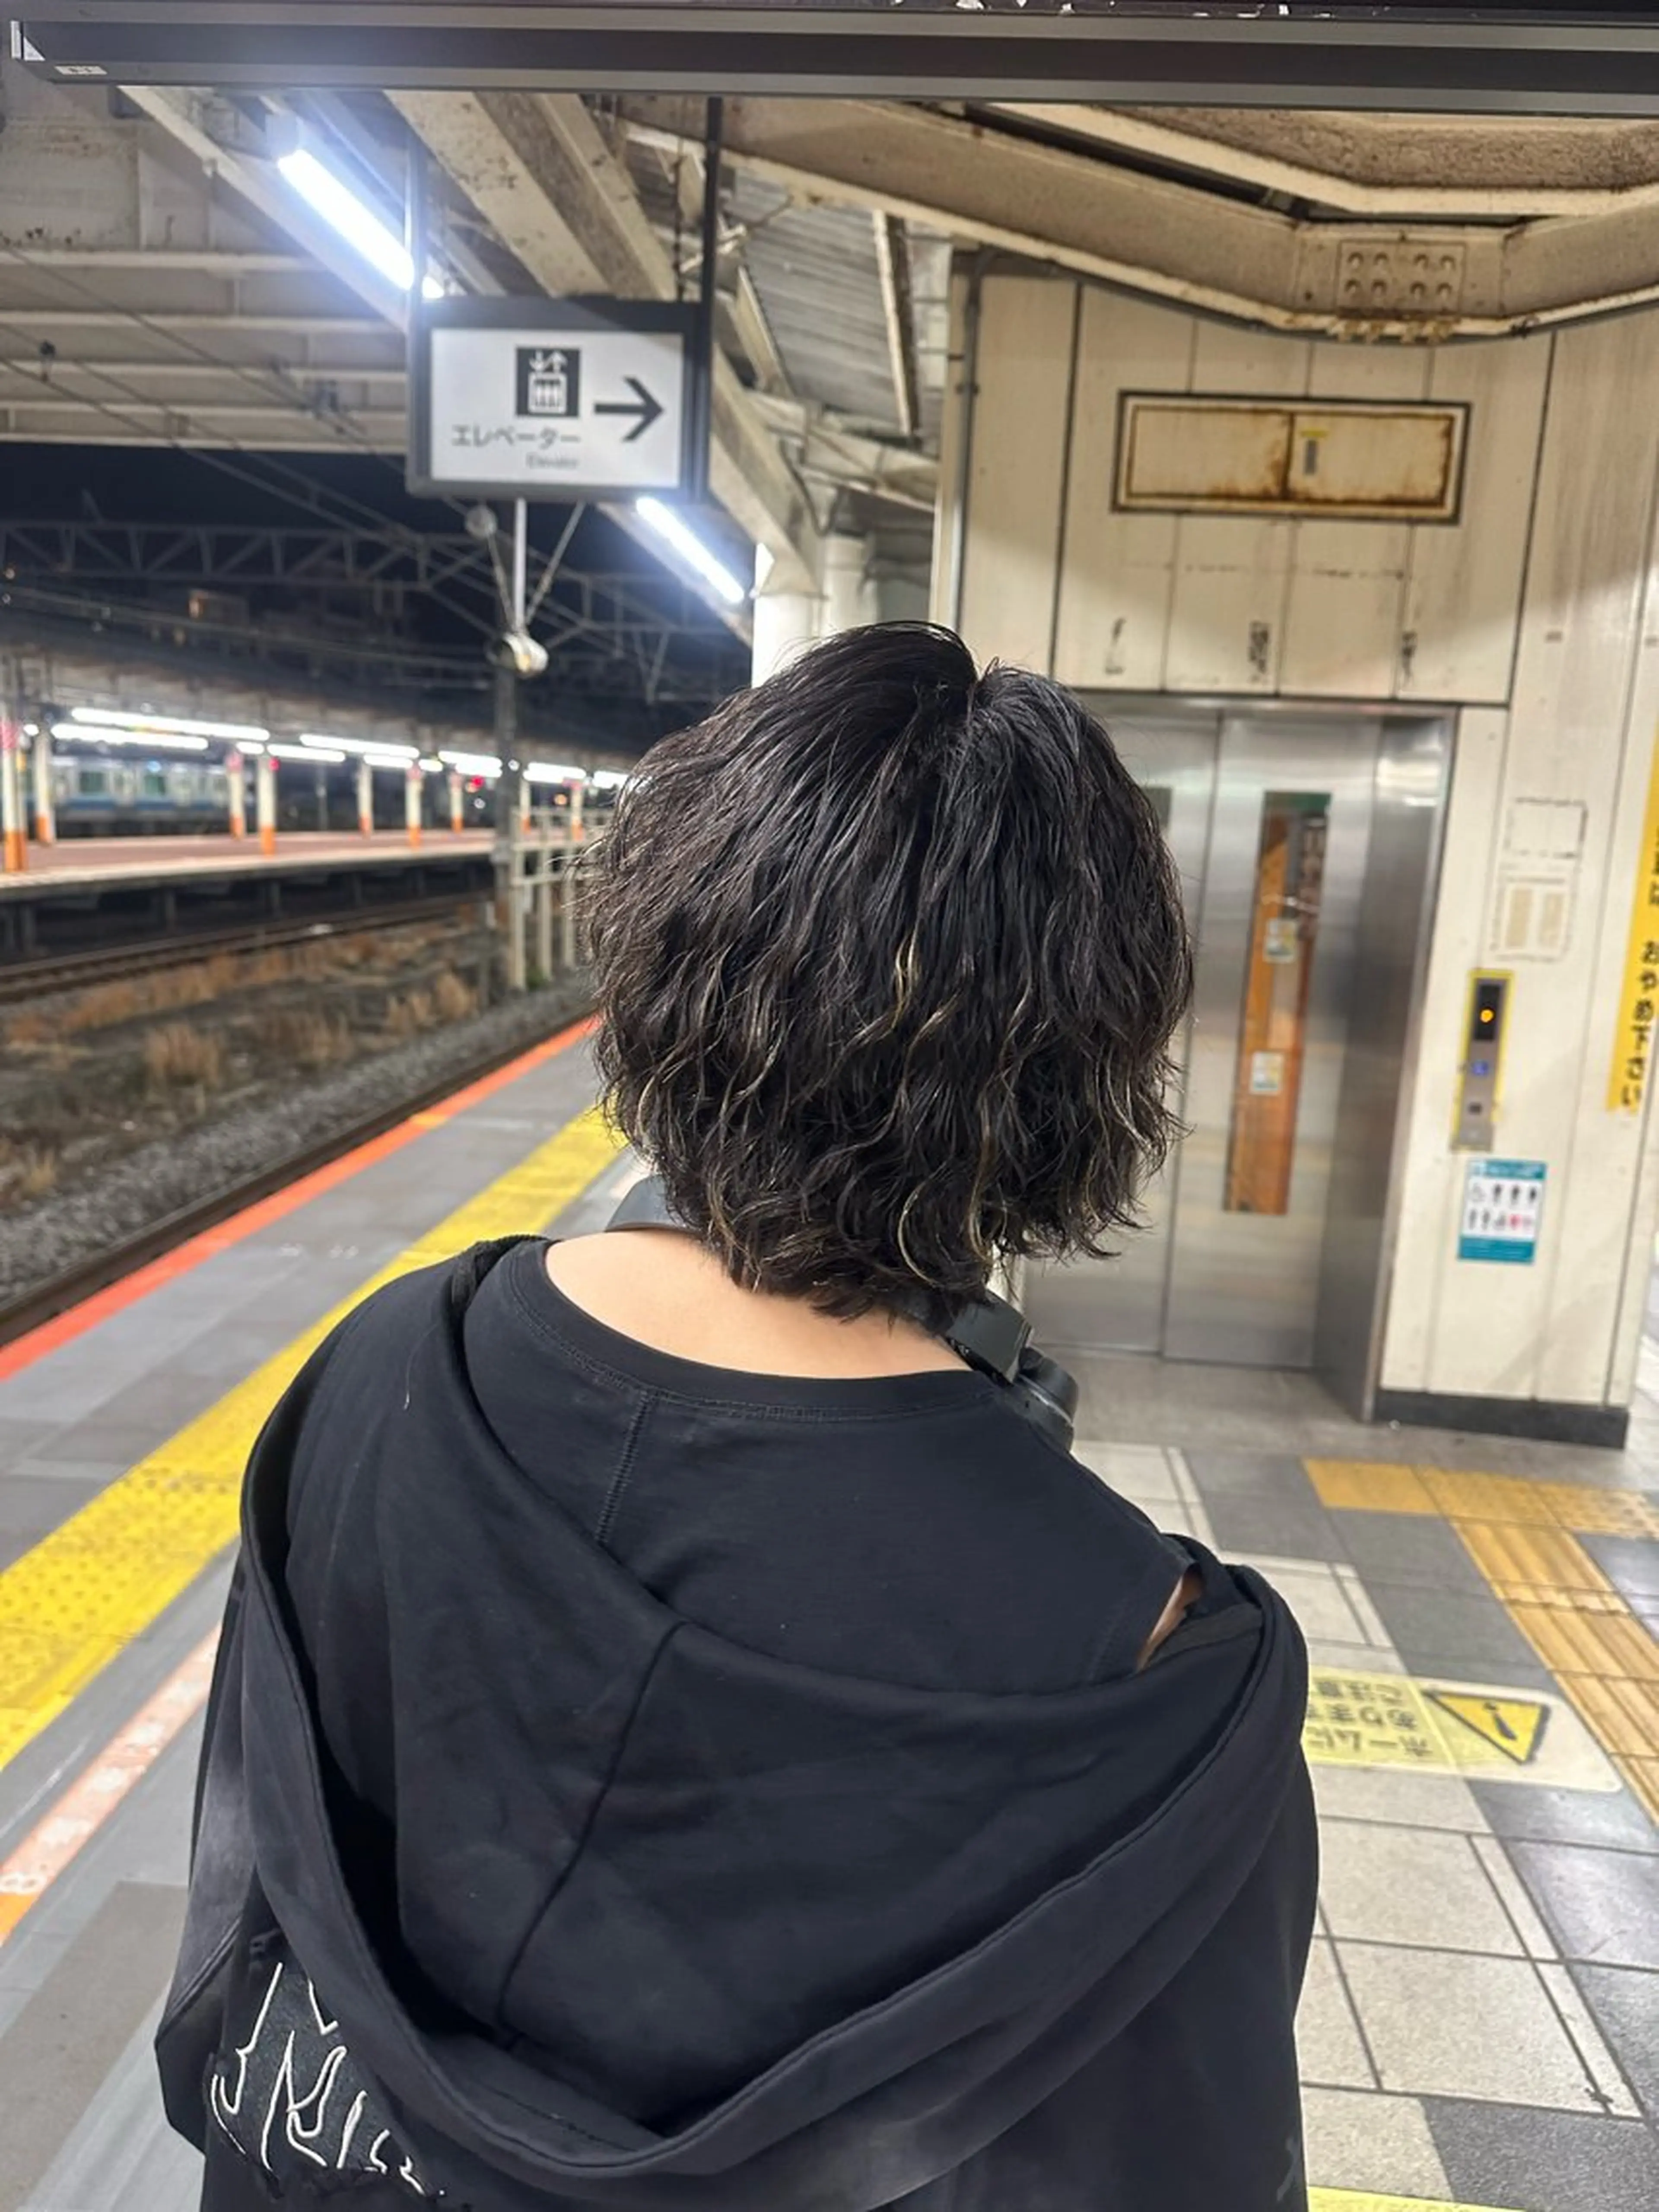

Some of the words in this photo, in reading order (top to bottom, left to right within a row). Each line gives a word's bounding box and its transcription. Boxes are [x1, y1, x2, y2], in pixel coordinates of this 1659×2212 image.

[451, 423, 581, 449] エレベーター
